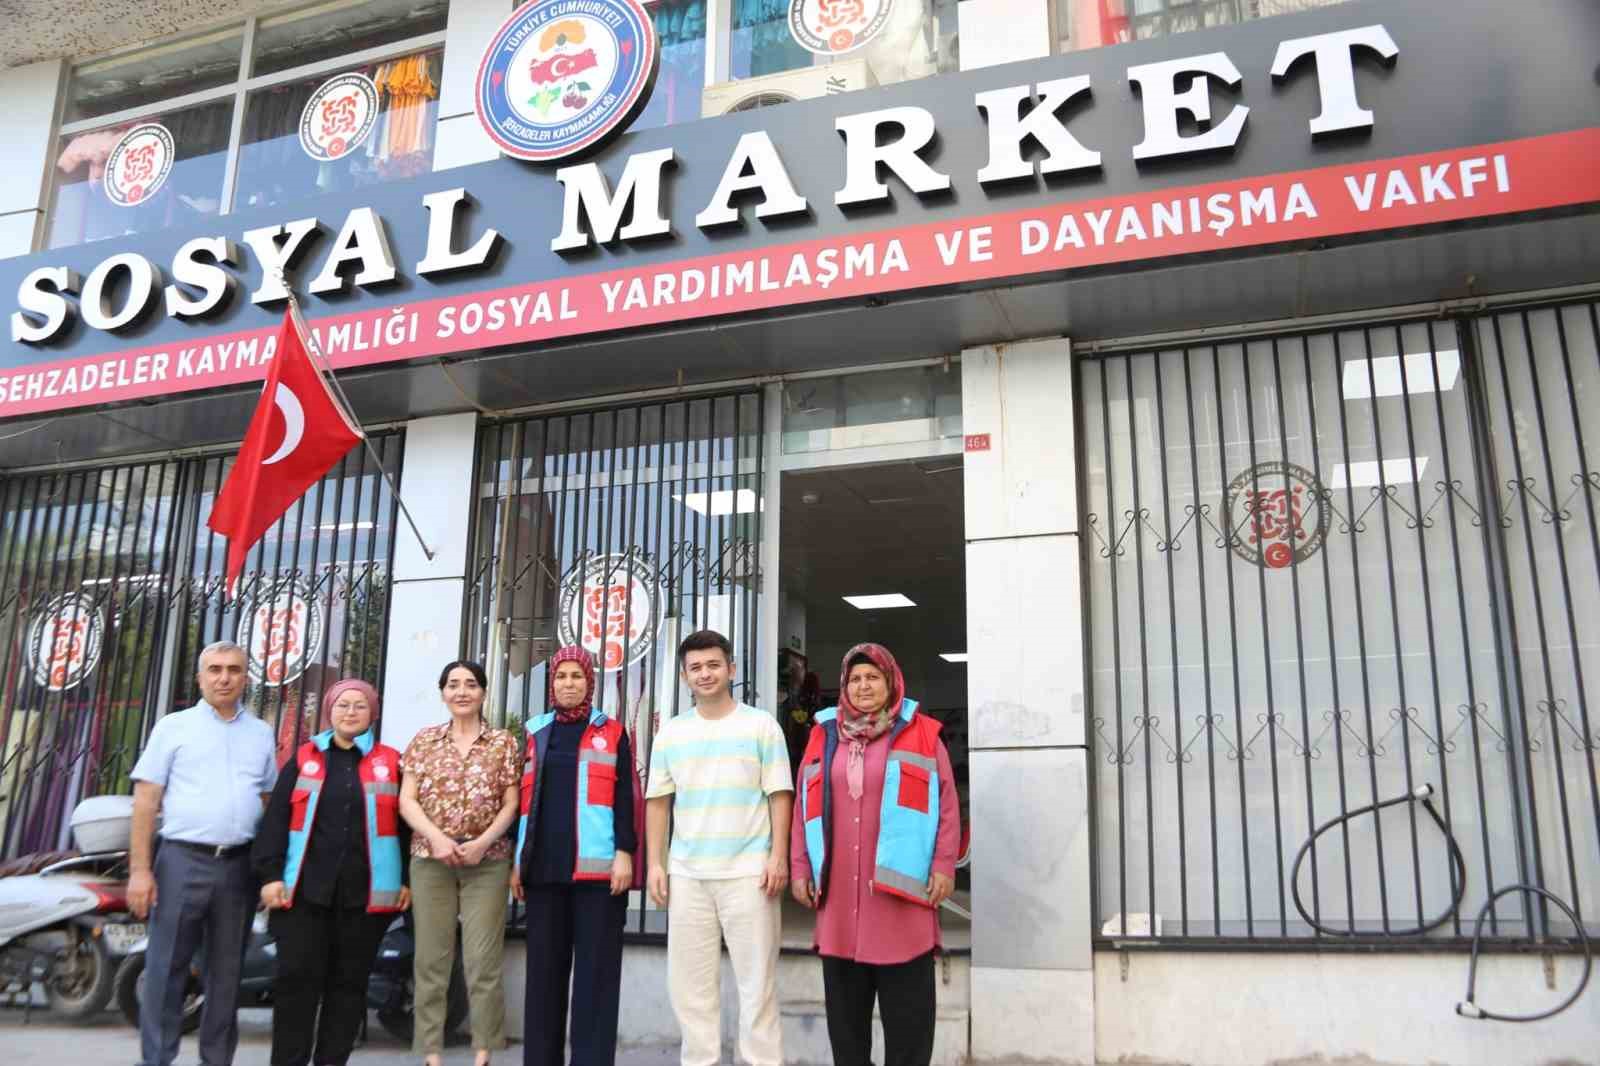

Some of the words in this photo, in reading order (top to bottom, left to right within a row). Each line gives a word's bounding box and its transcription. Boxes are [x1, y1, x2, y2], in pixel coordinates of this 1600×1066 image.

[504, 12, 549, 53] TÜRKİYE
[550, 1, 625, 28] CUMHURİYETİ
[11, 187, 499, 343] SOSYAL
[551, 24, 1400, 252] MARKET
[176, 307, 419, 378] KAYMAAMLIĞI
[436, 289, 578, 338] SOSYAL
[601, 239, 910, 314] YARDIMLAŞMA
[936, 226, 994, 265] VE
[1020, 183, 1318, 257] DAYANIŞMA
[1344, 155, 1511, 212] VAKFI
